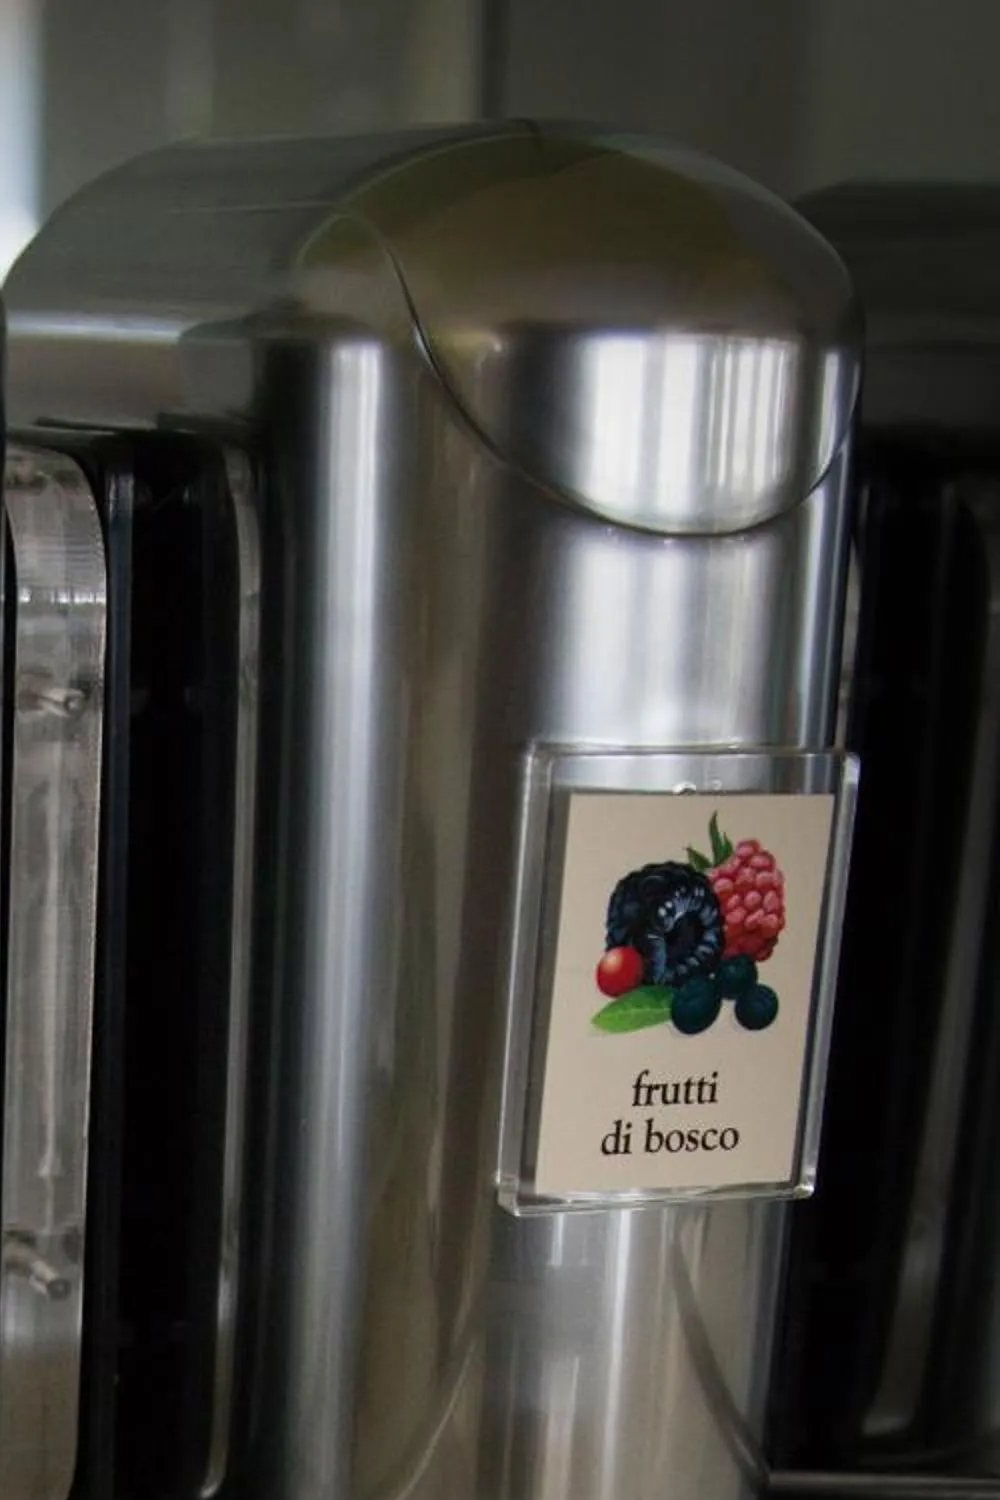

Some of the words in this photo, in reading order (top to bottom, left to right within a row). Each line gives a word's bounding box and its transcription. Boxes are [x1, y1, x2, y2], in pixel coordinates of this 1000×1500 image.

[631, 1069, 719, 1107] frutti
[600, 1118, 634, 1156] di
[643, 1117, 740, 1154] bosco
